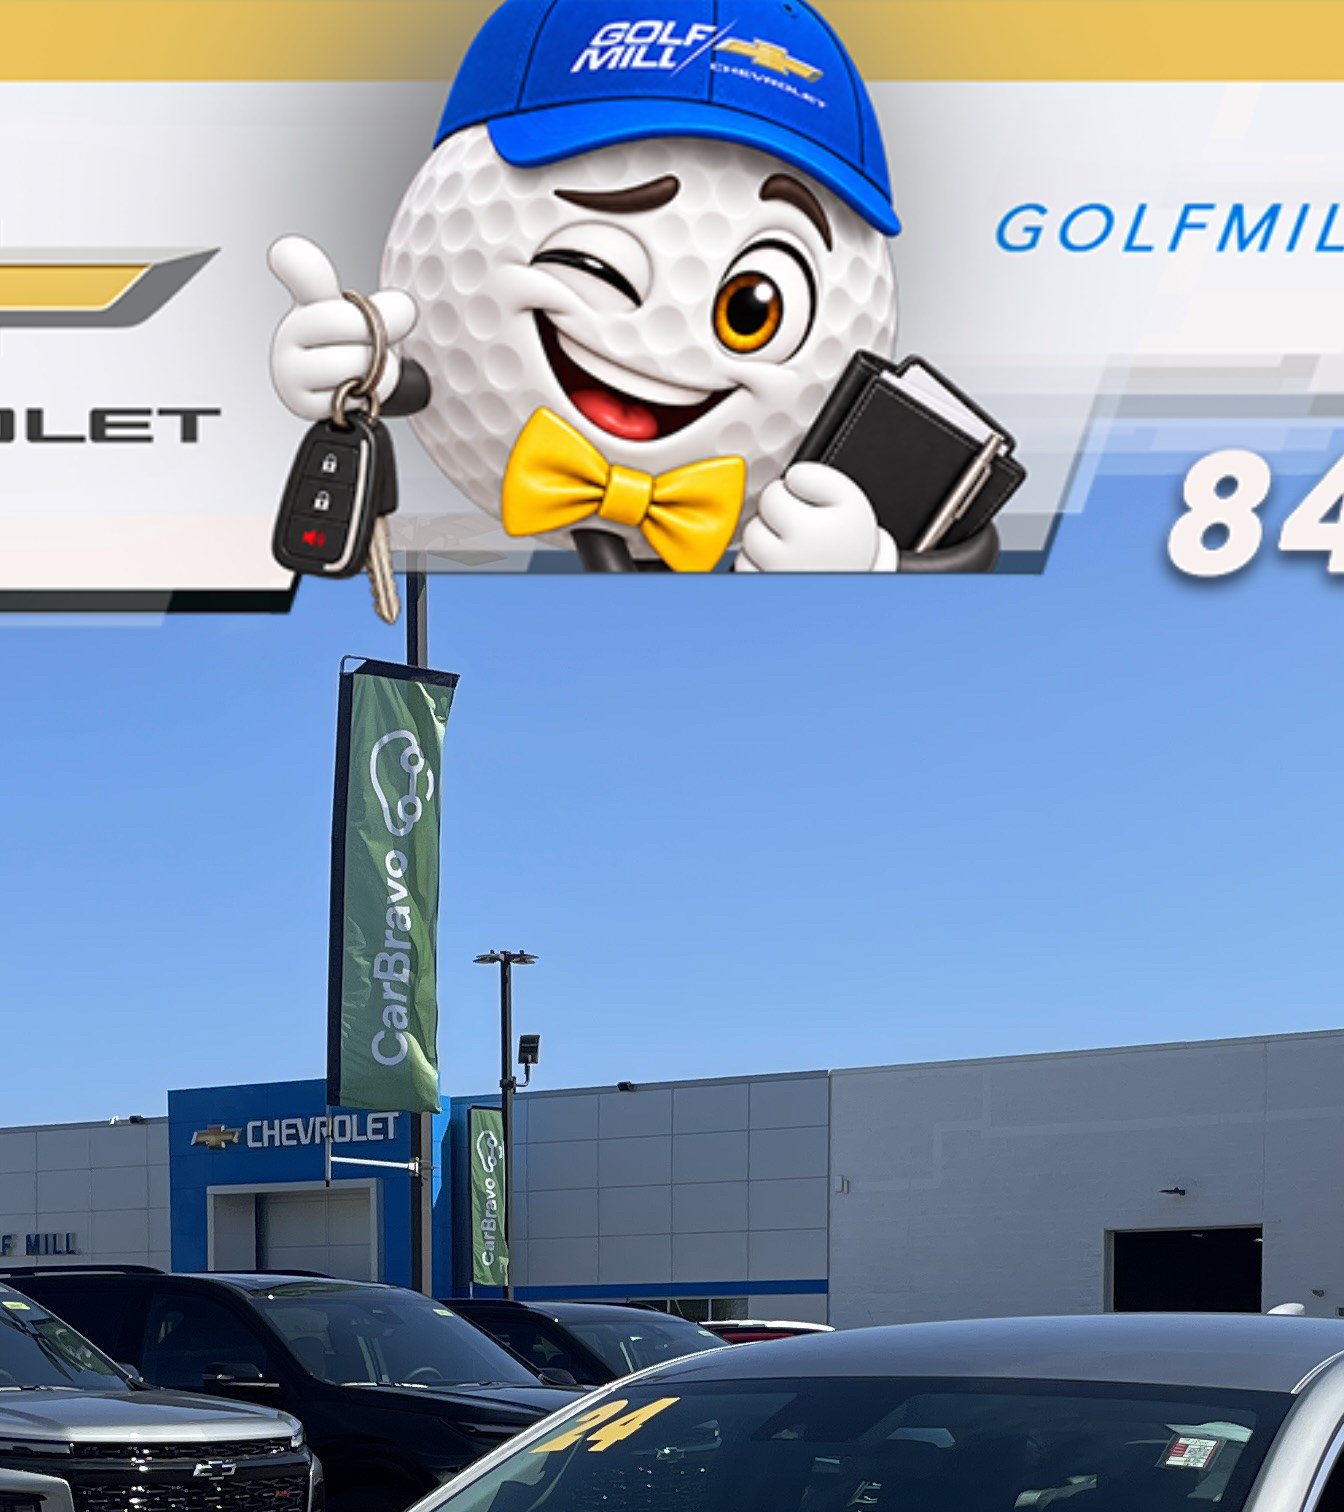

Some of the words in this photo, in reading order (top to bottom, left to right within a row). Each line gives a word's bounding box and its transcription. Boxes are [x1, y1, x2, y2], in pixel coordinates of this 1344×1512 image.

[370, 849, 412, 1067] CarBravo
[247, 1111, 400, 1148] CHEVROLET
[25, 1232, 78, 1256] MILL
[481, 1177, 497, 1266] CarBravo
[529, 1397, 680, 1453] 24
